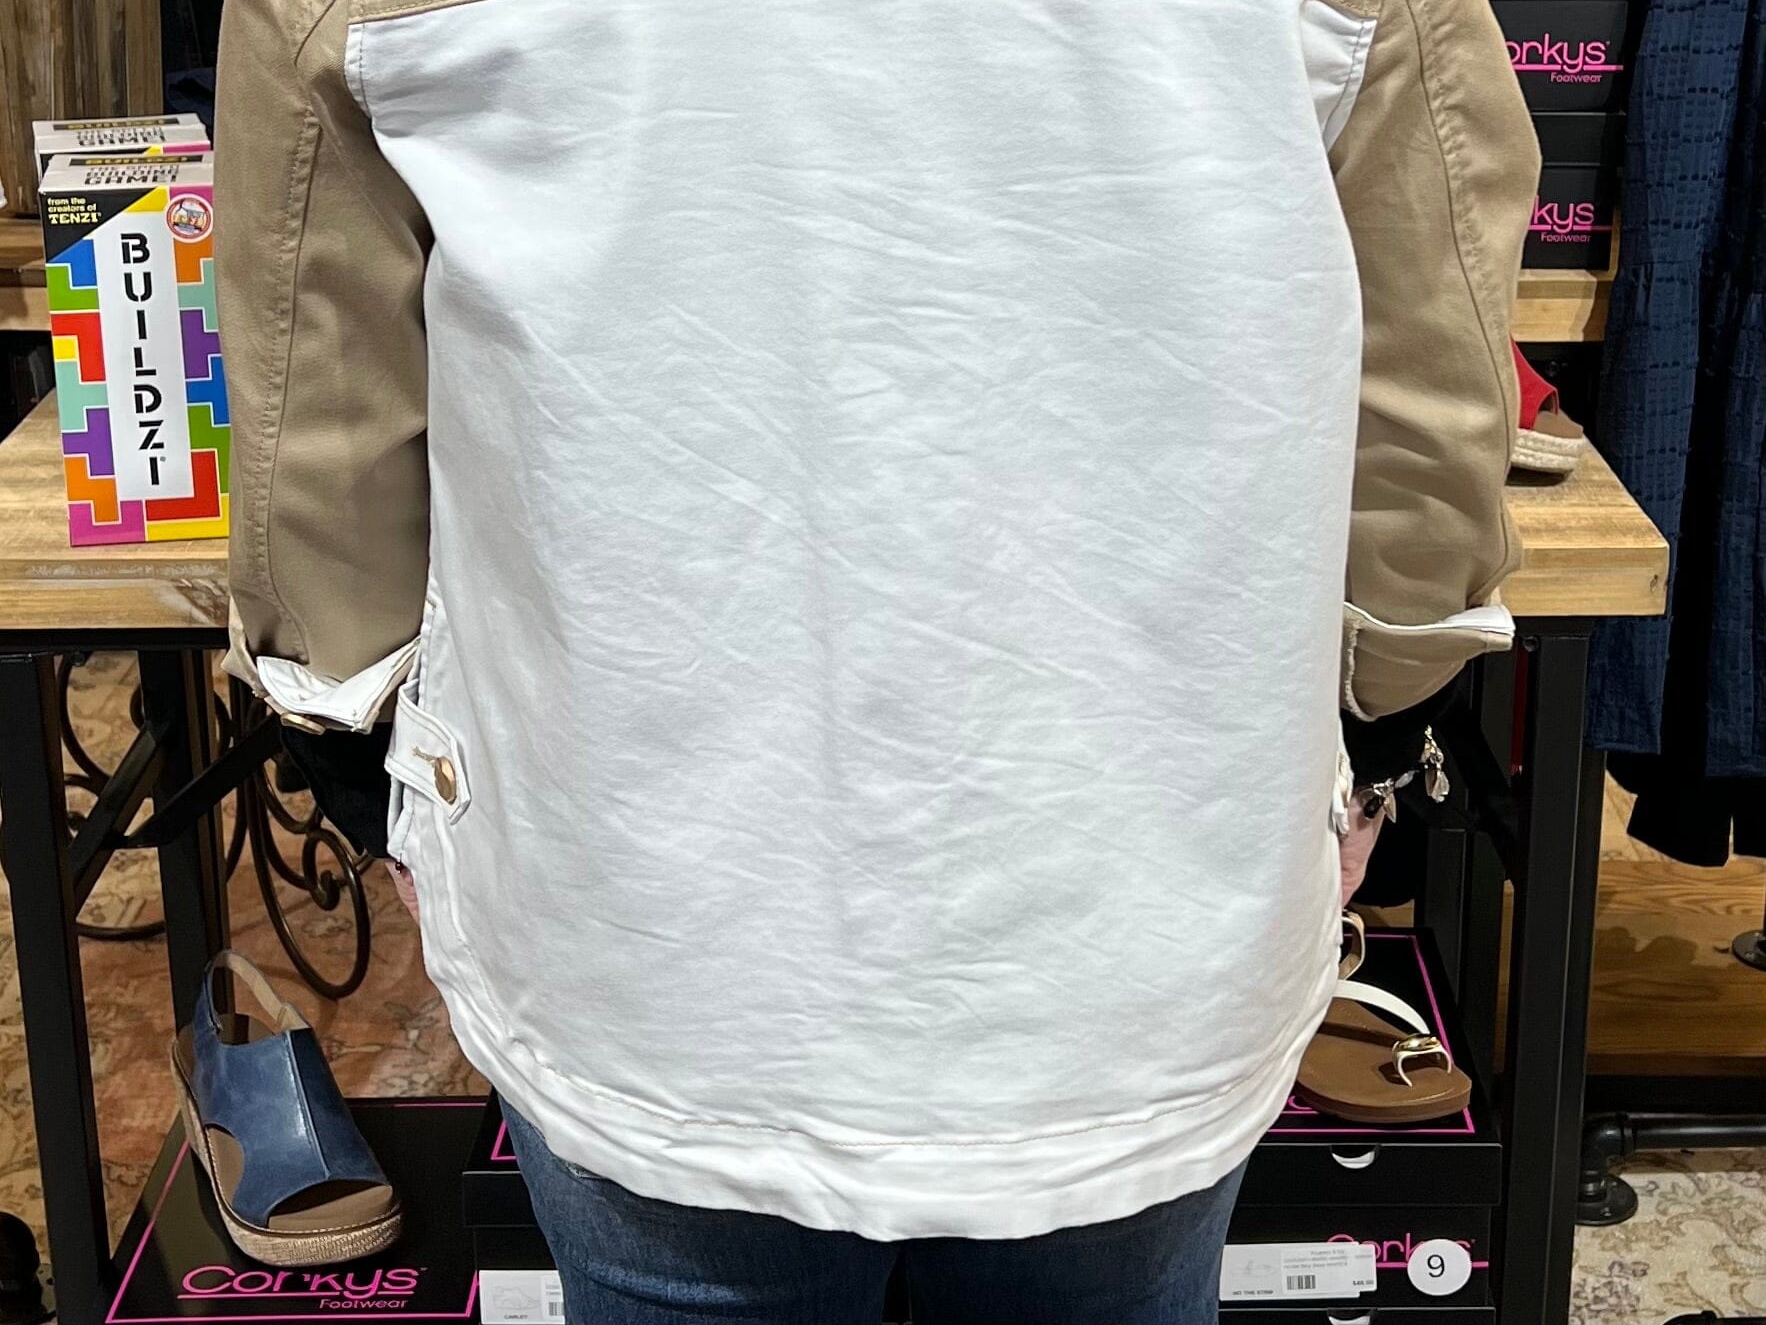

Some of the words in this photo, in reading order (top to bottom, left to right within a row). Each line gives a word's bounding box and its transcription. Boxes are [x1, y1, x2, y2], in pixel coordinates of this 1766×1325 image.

[1504, 33, 1607, 74] orkys
[1551, 72, 1602, 83] Footwear
[47, 197, 70, 206] from
[71, 196, 86, 205] the
[48, 204, 86, 213] creators
[86, 203, 97, 212] of
[48, 212, 99, 225] TENZI
[1541, 232, 1592, 244] Footwear
[120, 232, 164, 486] BUILDZI
[1426, 1253, 1446, 1278] 9
[319, 1298, 409, 1309] Footwear
